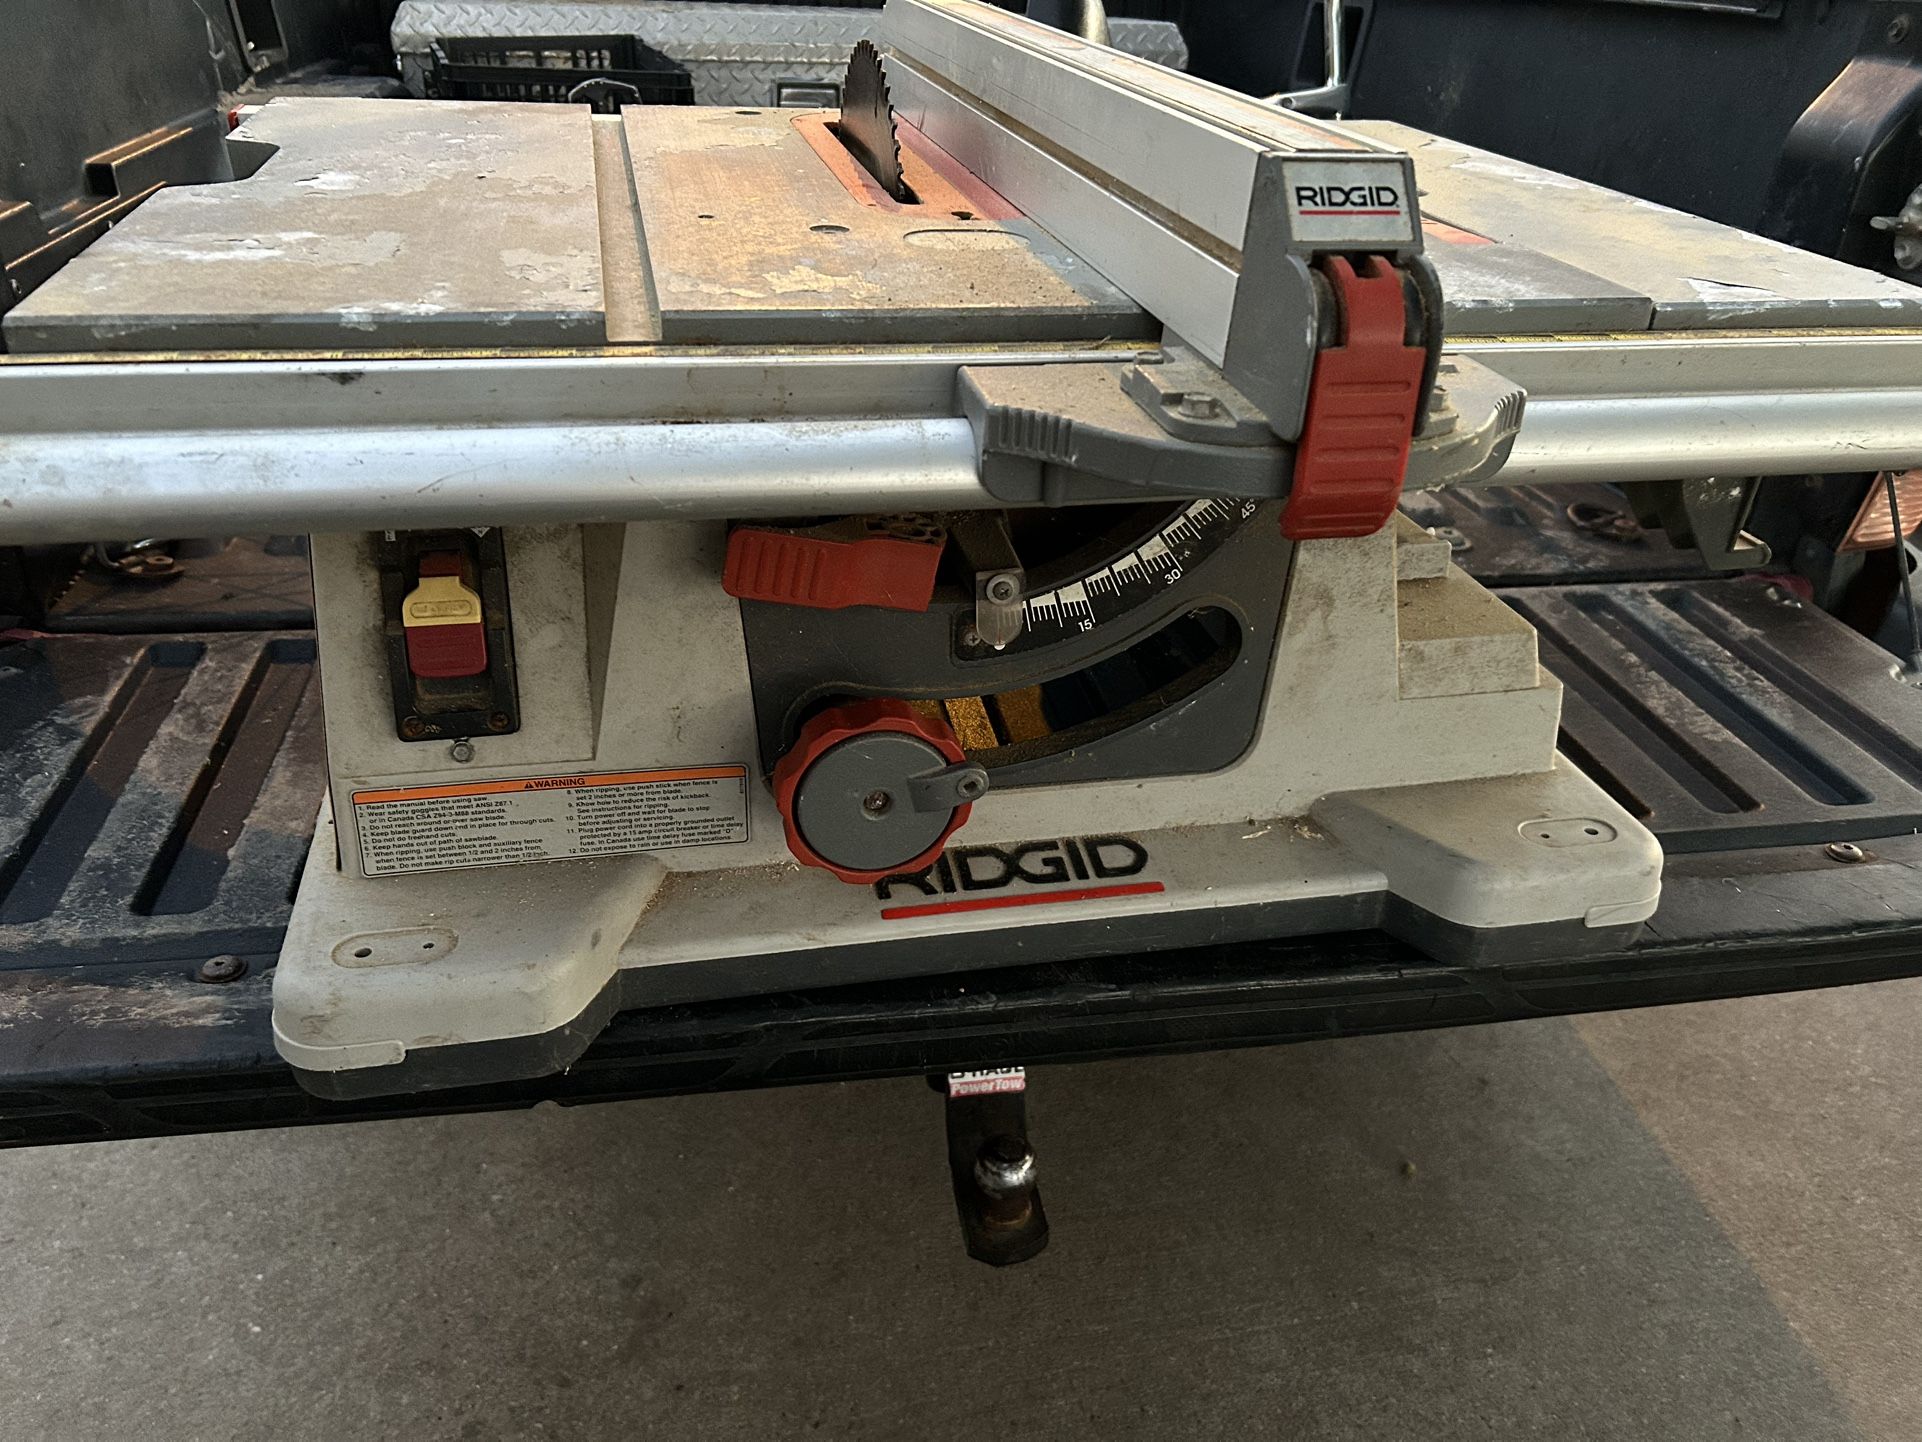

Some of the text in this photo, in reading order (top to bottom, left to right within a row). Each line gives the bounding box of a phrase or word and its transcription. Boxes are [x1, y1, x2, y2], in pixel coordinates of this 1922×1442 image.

[1295, 186, 1399, 207] RIDGID
[1164, 568, 1182, 585] 30
[1078, 619, 1093, 632] 15
[534, 778, 585, 788] WARNING
[411, 806, 439, 814] goggles
